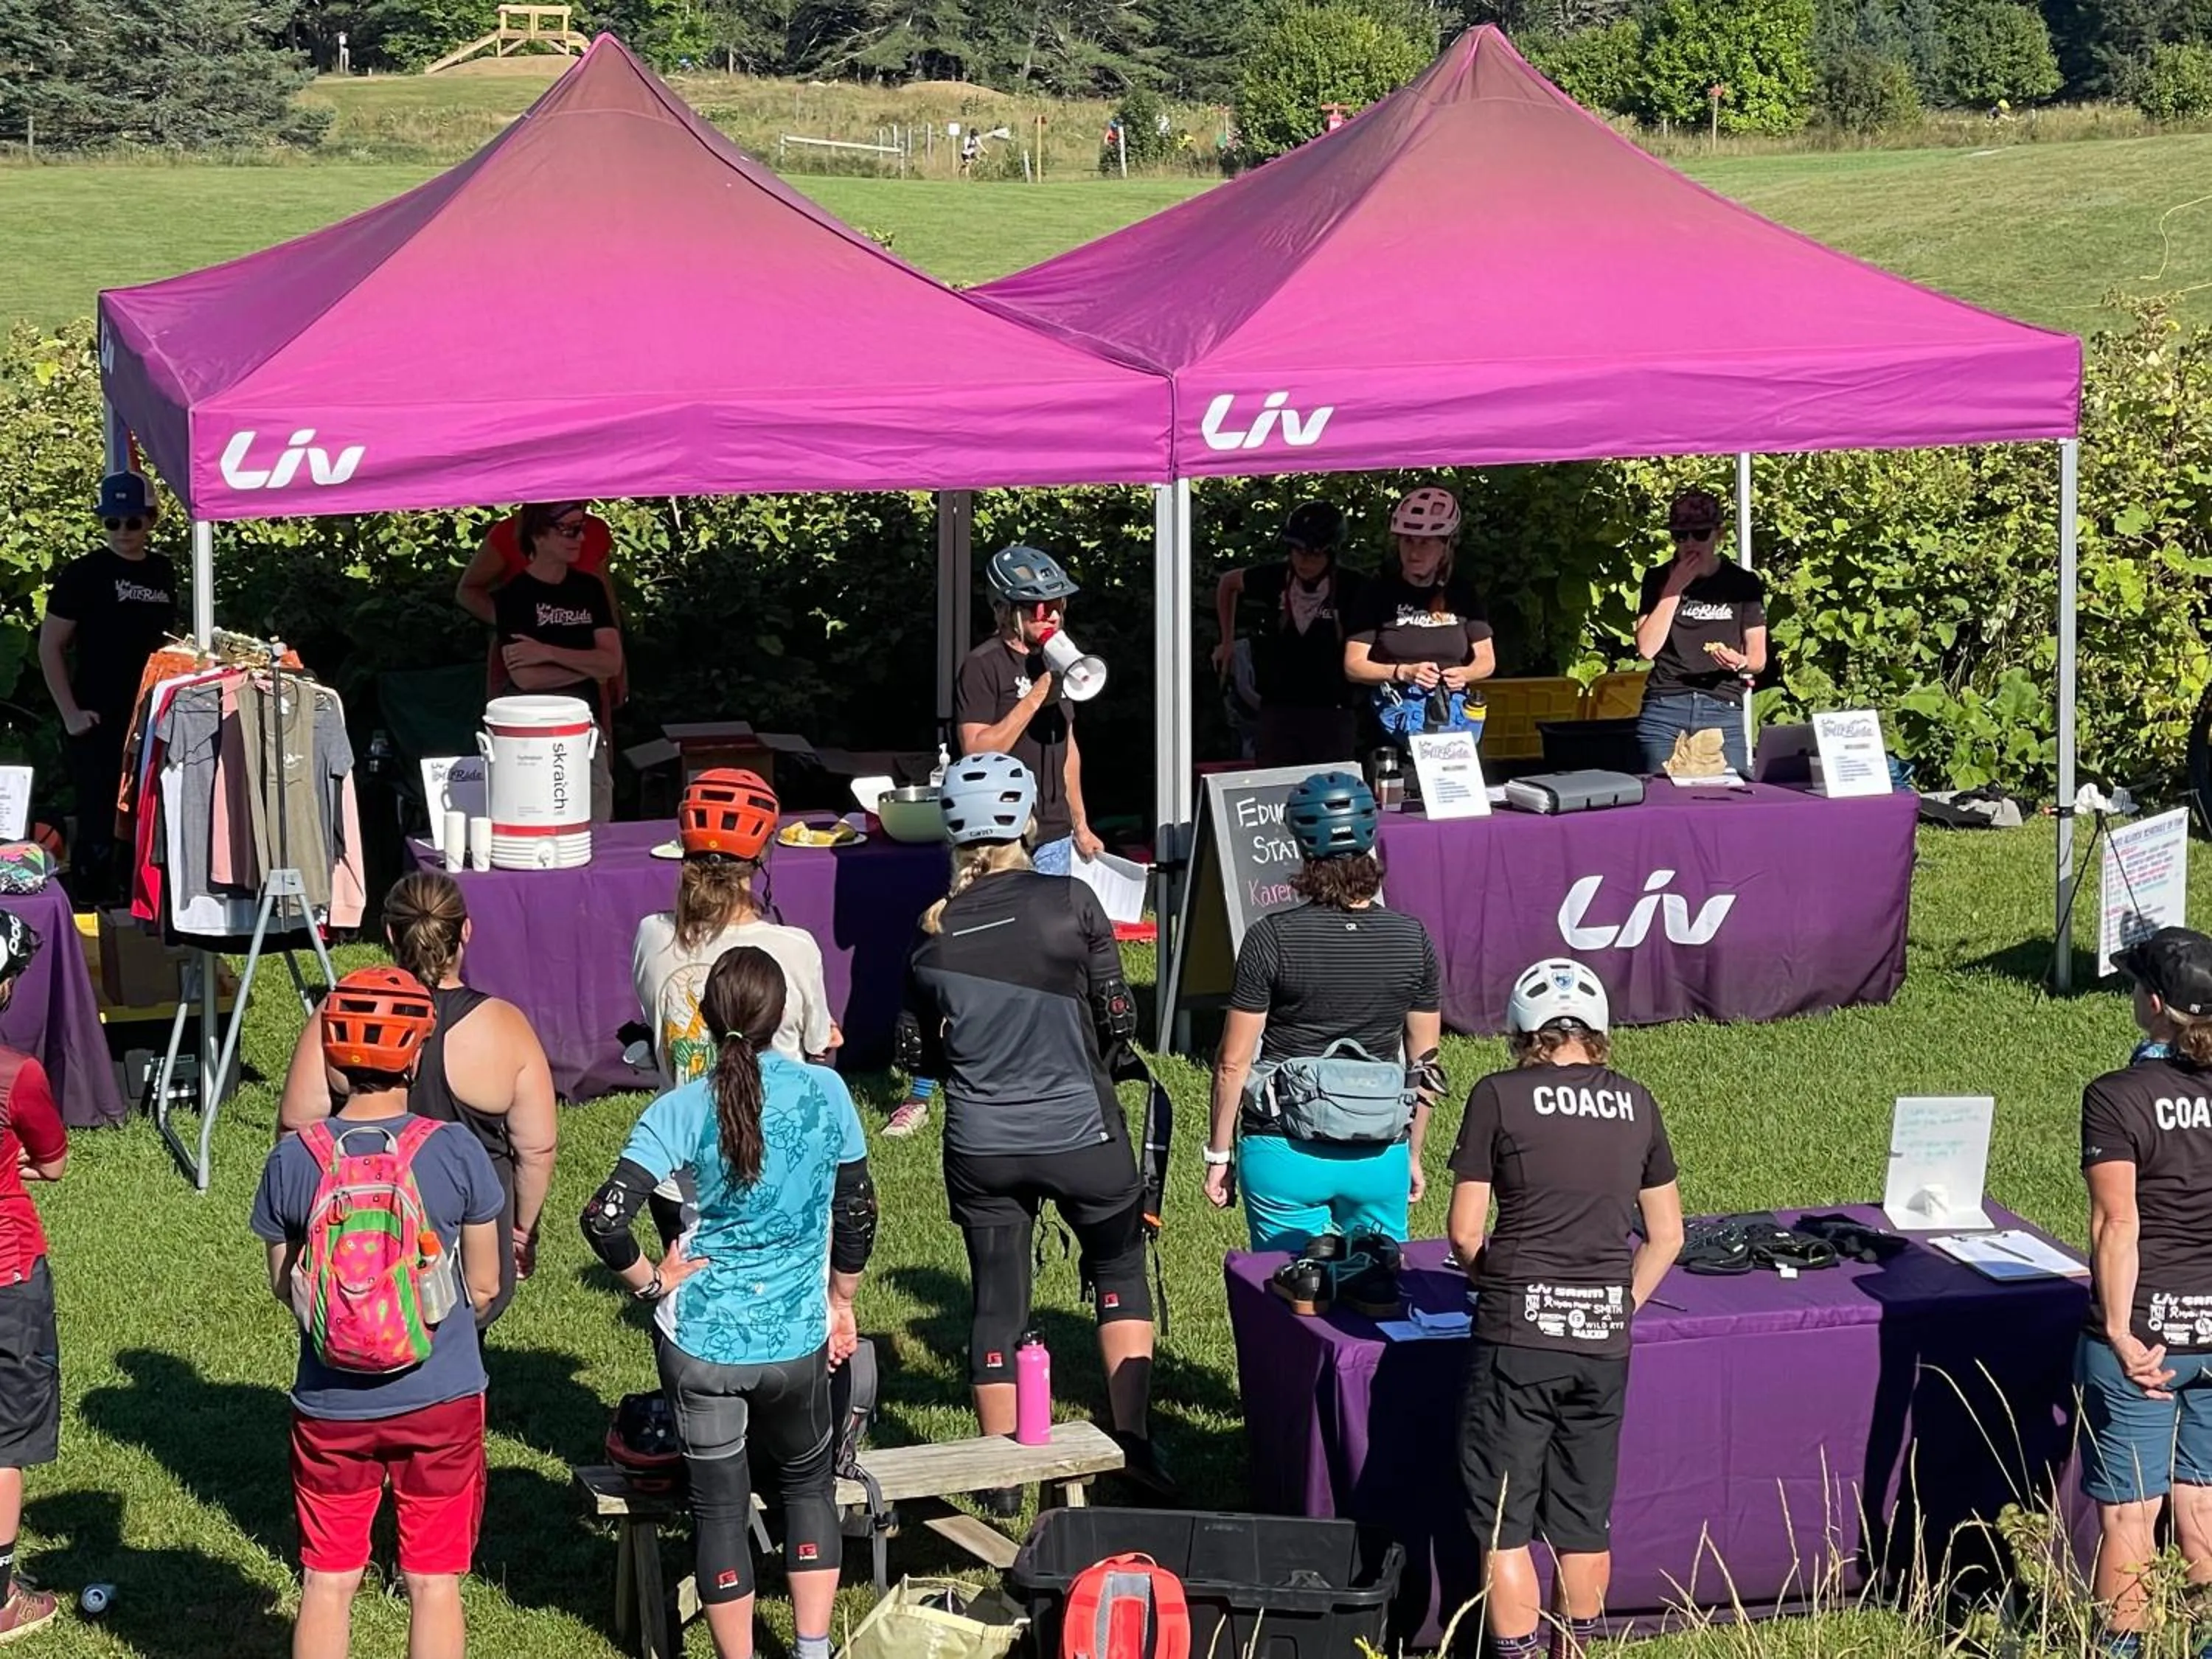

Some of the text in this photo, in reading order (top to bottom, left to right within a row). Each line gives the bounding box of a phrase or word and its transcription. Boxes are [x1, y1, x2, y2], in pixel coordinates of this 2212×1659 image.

[1201, 392, 1334, 451] Liv
[220, 429, 366, 490] Liv
[552, 742, 570, 810] skratch
[1557, 869, 1736, 950] Liv
[8, 915, 21, 956] POC
[1533, 1085, 1635, 1121] COACH
[2155, 1096, 2212, 1130] COA
[1593, 1304, 1623, 1315] SMITH
